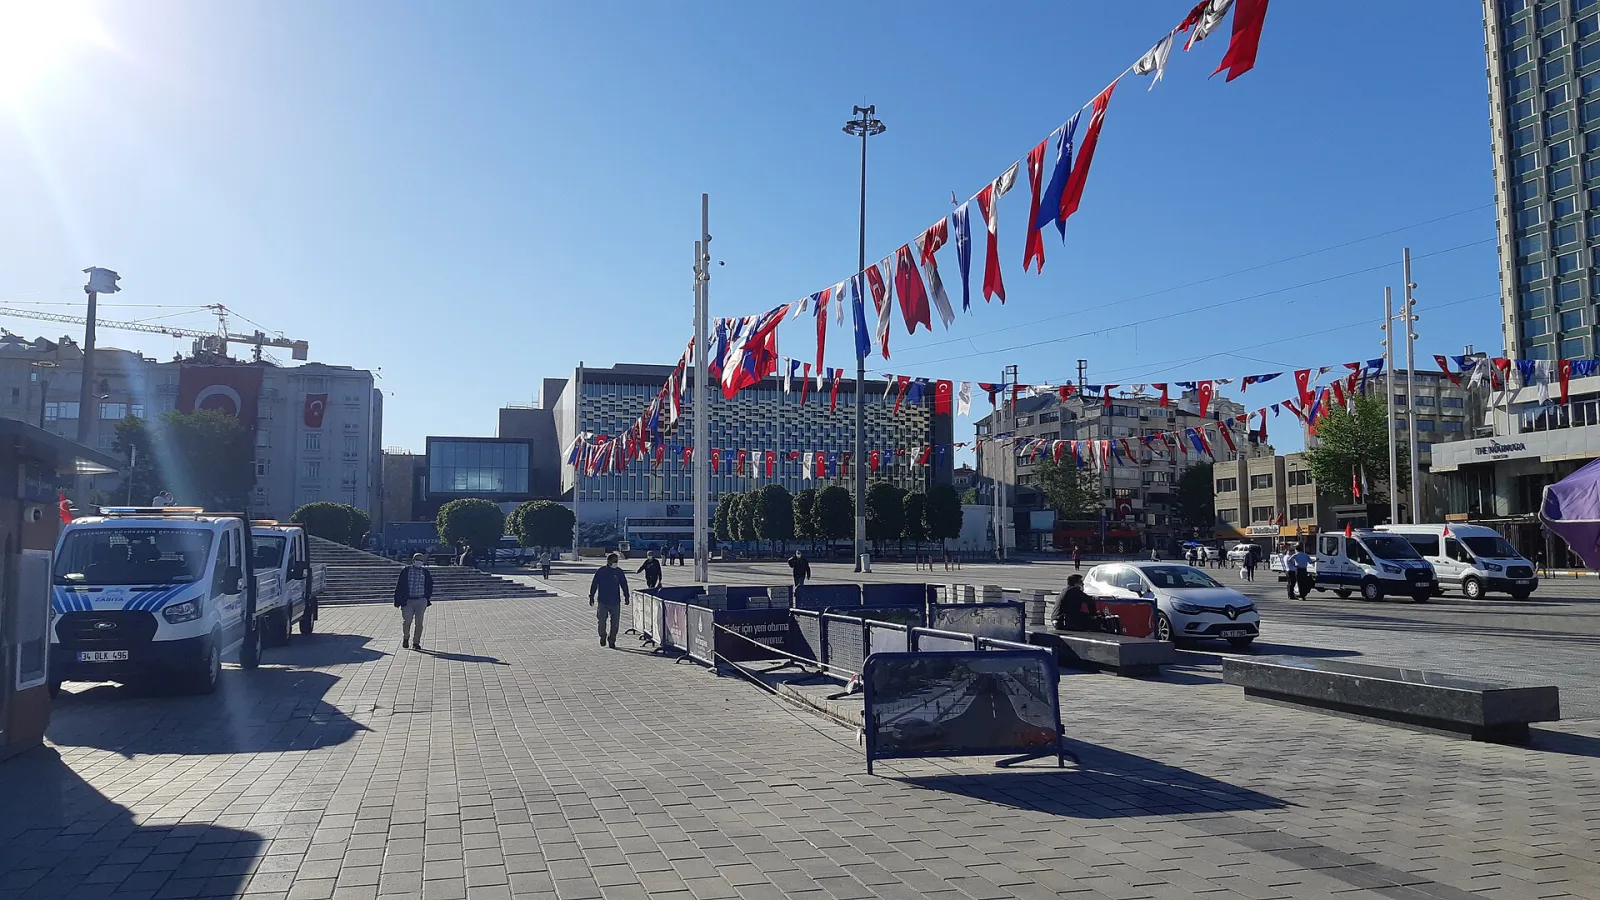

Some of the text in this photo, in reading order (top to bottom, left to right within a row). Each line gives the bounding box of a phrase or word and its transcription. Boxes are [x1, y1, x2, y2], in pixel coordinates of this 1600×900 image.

[741, 623, 753, 635] için
[754, 622, 767, 635] yeni
[767, 623, 789, 632] oturma
[95, 652, 109, 660] DLK
[112, 651, 127, 659] 496
